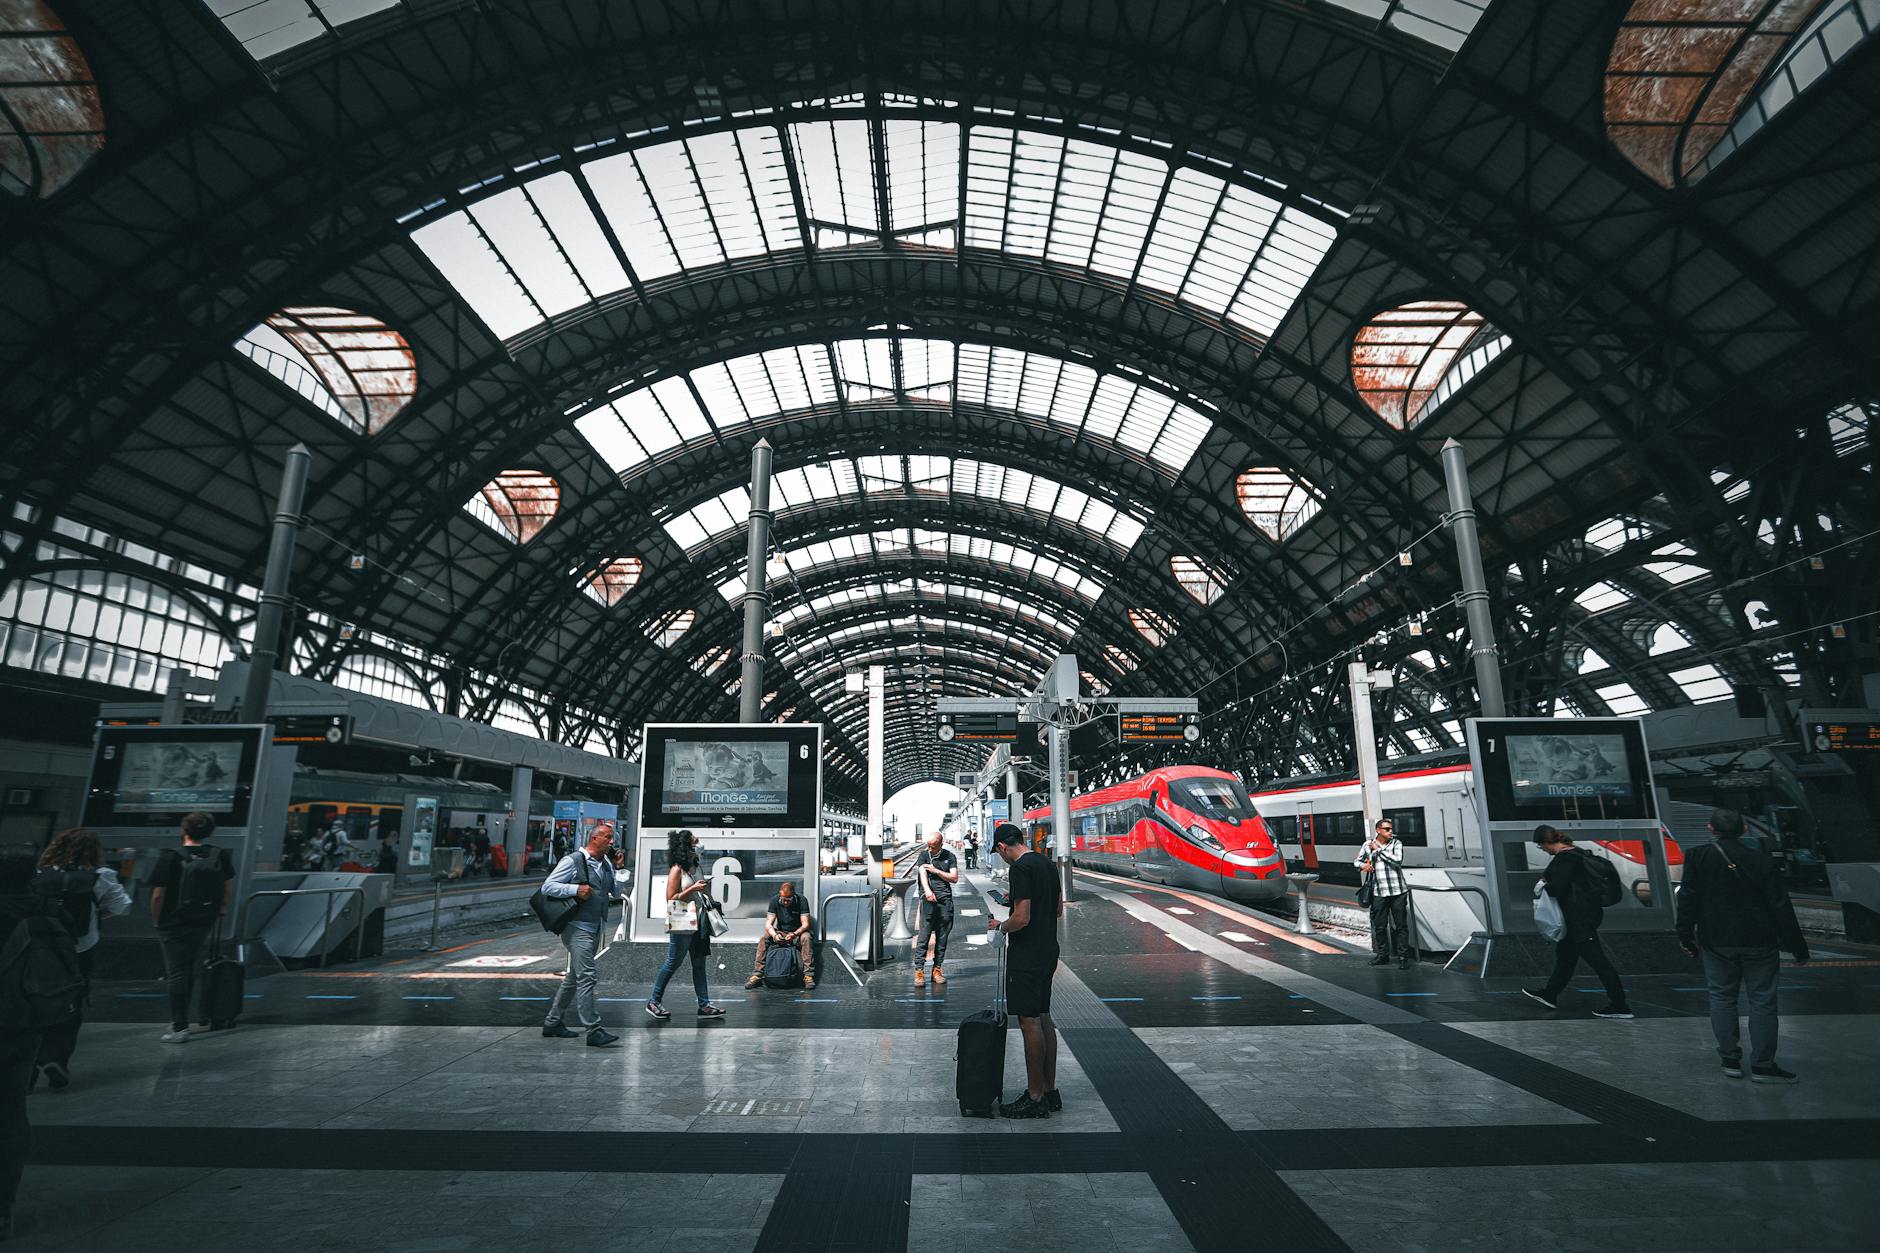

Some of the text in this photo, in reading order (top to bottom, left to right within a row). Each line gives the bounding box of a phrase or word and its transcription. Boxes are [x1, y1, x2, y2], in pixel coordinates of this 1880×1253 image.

[941, 715, 947, 723] 6
[1190, 715, 1196, 723] 7
[104, 746, 115, 760] 5
[800, 745, 808, 759] 6
[1487, 739, 1495, 753] 7
[711, 856, 742, 912] 6
